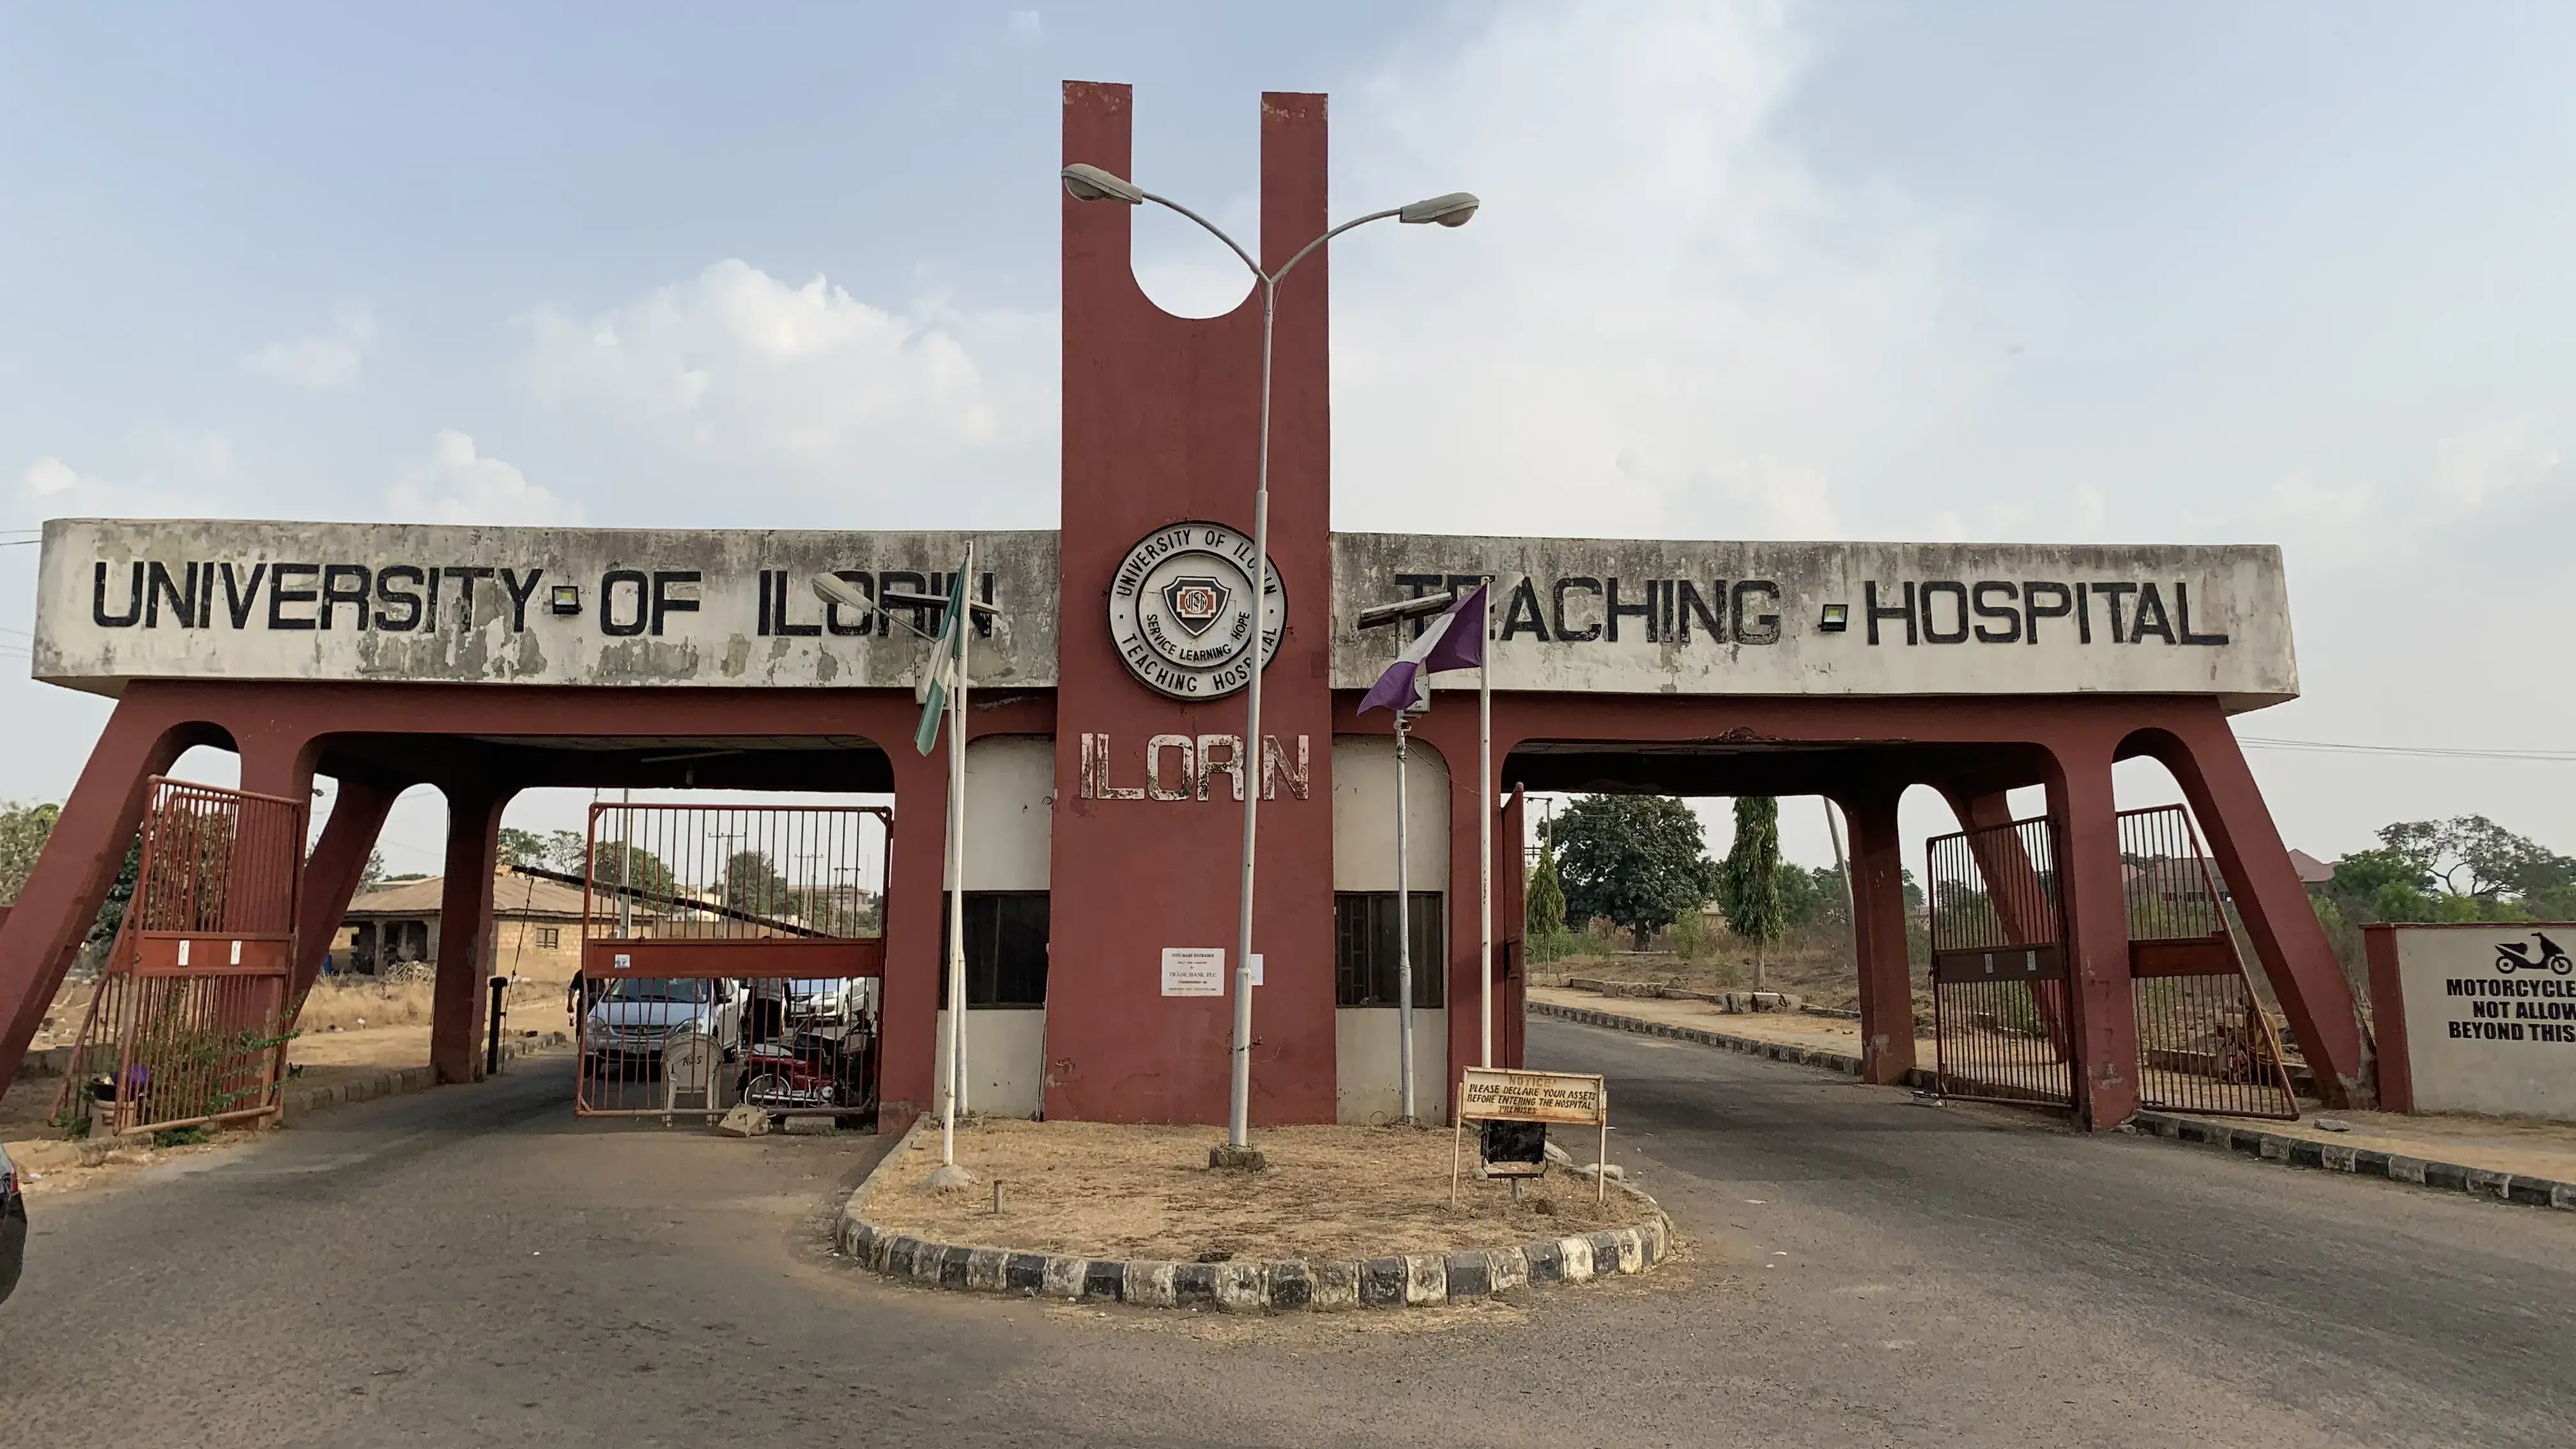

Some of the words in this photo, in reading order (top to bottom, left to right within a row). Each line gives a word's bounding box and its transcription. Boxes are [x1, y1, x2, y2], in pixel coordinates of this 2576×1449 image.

[1116, 529, 1192, 597] UNIVERSITY
[1205, 530, 1226, 548] OF
[1232, 541, 1277, 595] ILIN
[93, 561, 544, 633] UNIVERSITY
[600, 569, 702, 636] OF
[1865, 580, 2229, 646] HOSPITAL
[1147, 614, 1177, 656] SERVICE
[1179, 643, 1232, 662] LEARNING
[1230, 611, 1250, 641] HOPE
[1122, 632, 1197, 693] TEACHING
[1213, 627, 1277, 691] HOSPAL
[1081, 733, 1309, 801] ILORN
[2446, 979, 2576, 997] MOTORCYCLE
[2473, 1000, 2510, 1018] NOT
[2448, 1021, 2524, 1040] BEYOND
[2528, 1023, 2575, 1043] THIS
[1467, 1094, 1496, 1103] BEFORE
[1498, 1095, 1536, 1106] ENTERING
[1539, 1098, 1553, 1107] THE
[1554, 1100, 1591, 1110] HOSPITAL
[1469, 1084, 1501, 1094] PLEASE
[1503, 1086, 1540, 1097] DECLARE
[1543, 1089, 1565, 1098] YOUR
[1568, 1091, 1596, 1101] ASSETS
[1499, 1105, 1537, 1115] PREMISES
